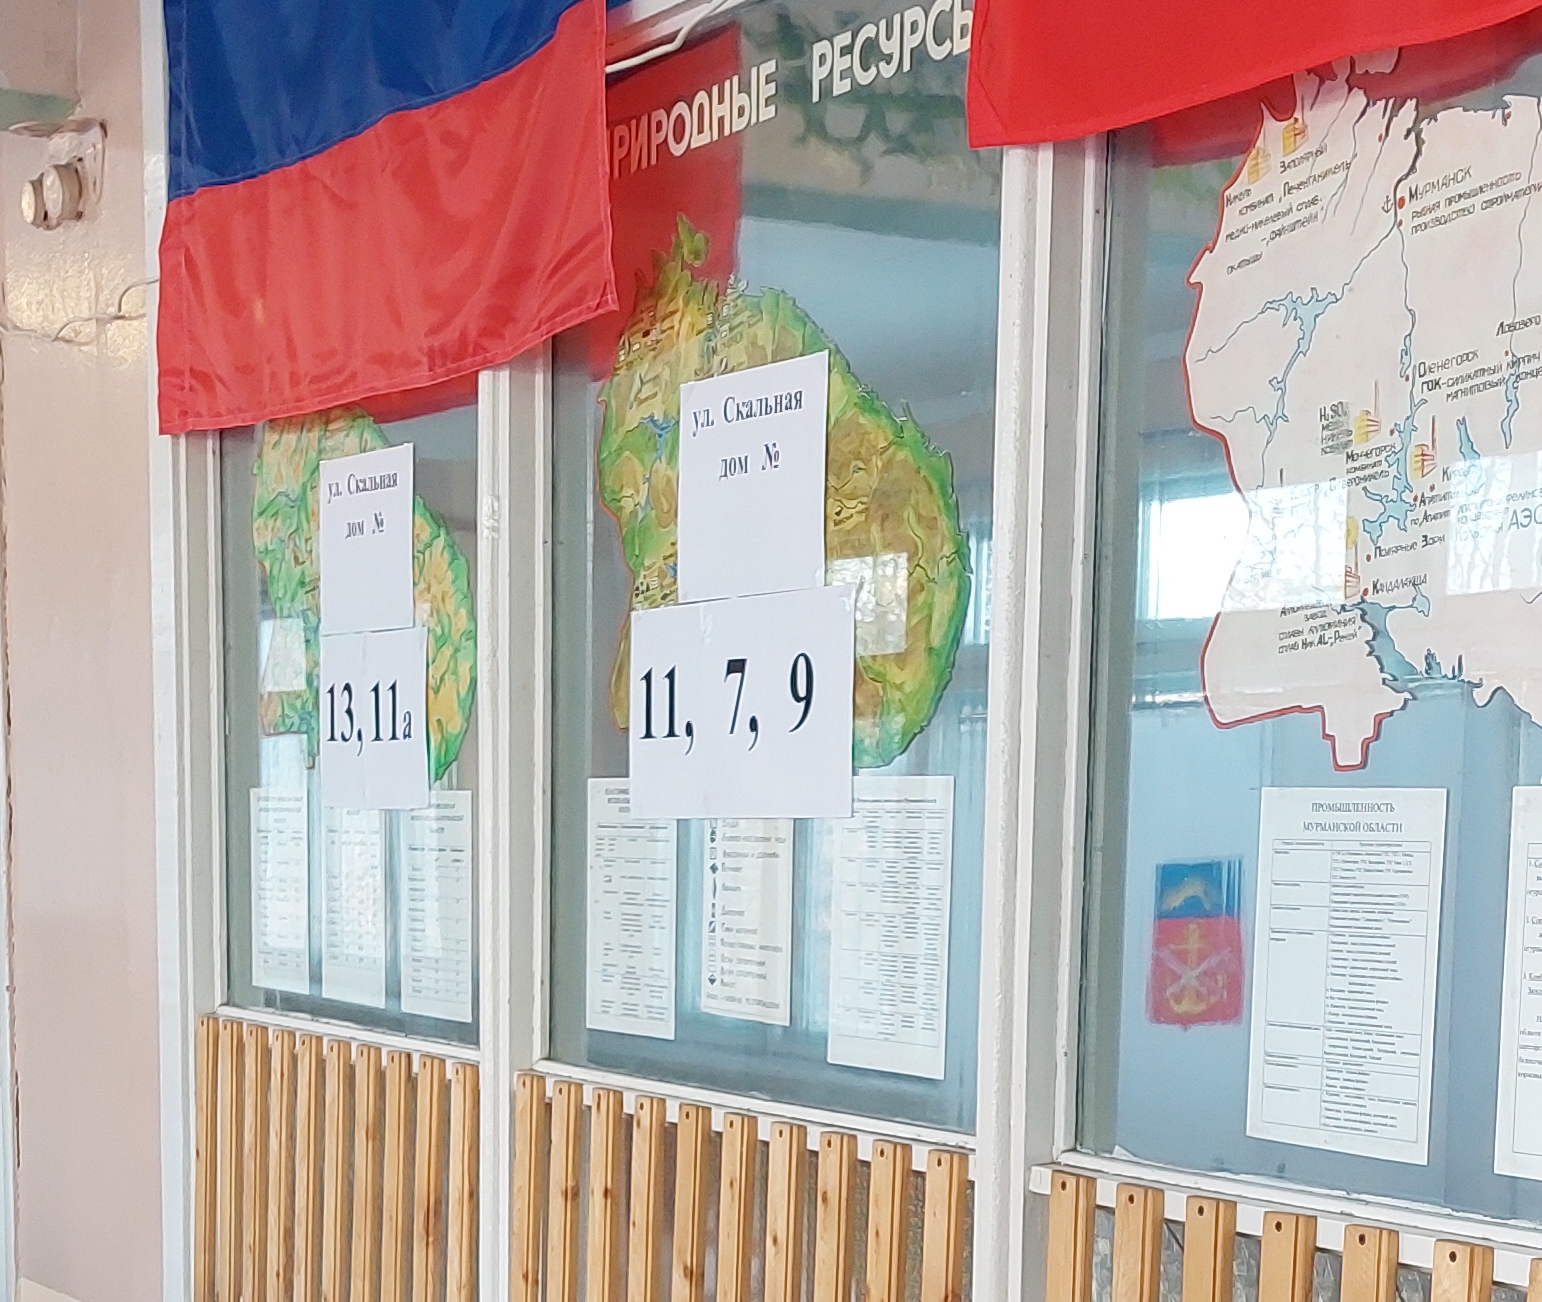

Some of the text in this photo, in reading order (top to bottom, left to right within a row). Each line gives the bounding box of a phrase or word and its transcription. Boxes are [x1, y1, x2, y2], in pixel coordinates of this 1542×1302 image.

[609, 58, 778, 181] РИРОДНЫЕ
[692, 390, 803, 437] ул. Скальная
[719, 442, 780, 481] дом №
[347, 473, 398, 495] Скальная
[345, 511, 384, 539] дом №
[325, 682, 364, 757] 13,
[639, 652, 814, 757] 11, 7, 9
[1303, 820, 1403, 833] МУРМАНСКОЙ ОБЛАСТИ
[1311, 801, 1395, 814] ПРОМЫШЛЕННОСТЬ
